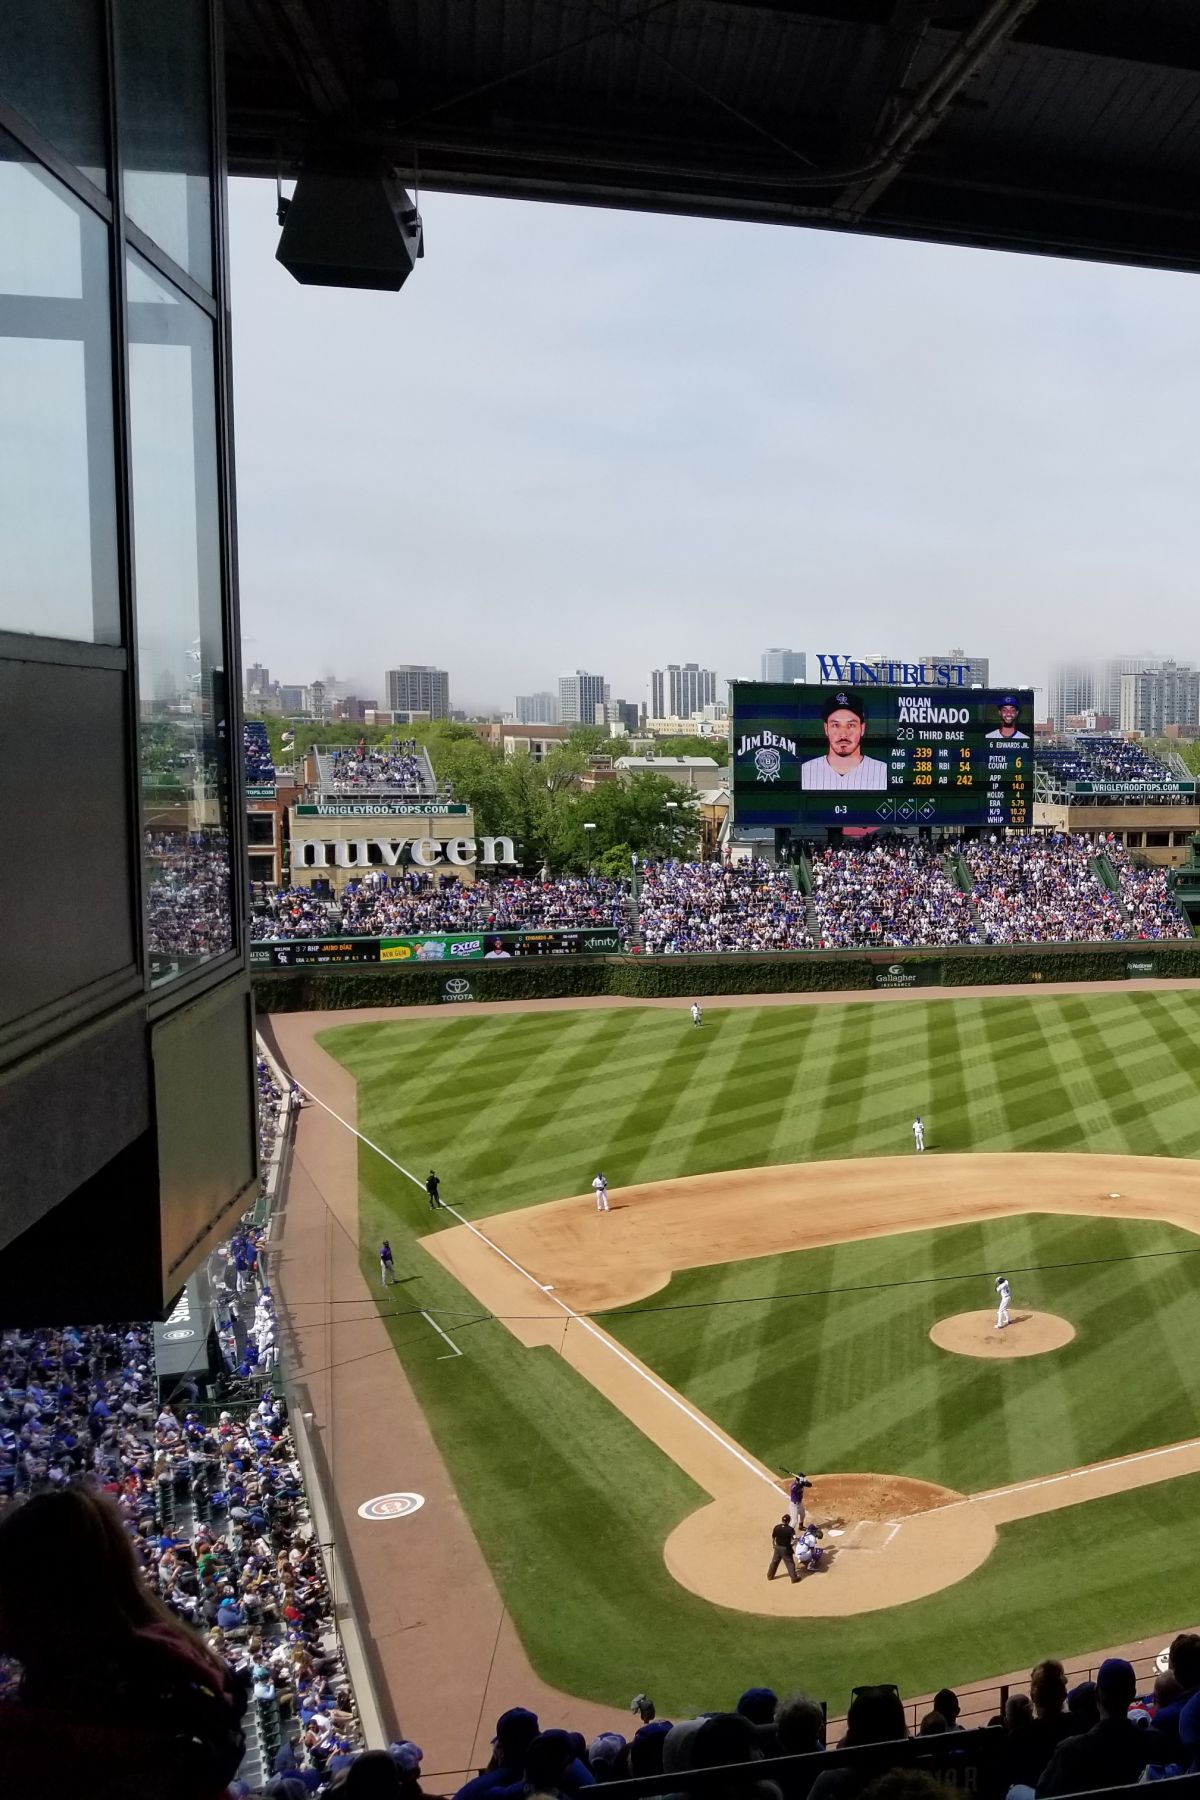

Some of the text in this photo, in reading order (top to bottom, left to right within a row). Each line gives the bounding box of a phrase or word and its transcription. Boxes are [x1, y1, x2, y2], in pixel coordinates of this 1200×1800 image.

[816, 654, 970, 686] WINTRUST
[898, 696, 931, 708] NOLAN
[898, 708, 970, 724] ARENADO
[896, 728, 965, 740] 28 THIRD BASE
[738, 730, 798, 756] JIM BEAM
[912, 747, 932, 758] .339
[959, 748, 971, 758] 16
[912, 761, 932, 772] .388
[959, 761, 971, 771] 54
[1015, 756, 1022, 768] 6
[912, 775, 932, 785] .620
[956, 775, 973, 785] 242
[834, 805, 848, 814] 0-3
[291, 836, 518, 868] nuveen
[451, 940, 480, 954] Extra
[584, 937, 617, 948] xfinity
[876, 974, 916, 983] Gallagher
